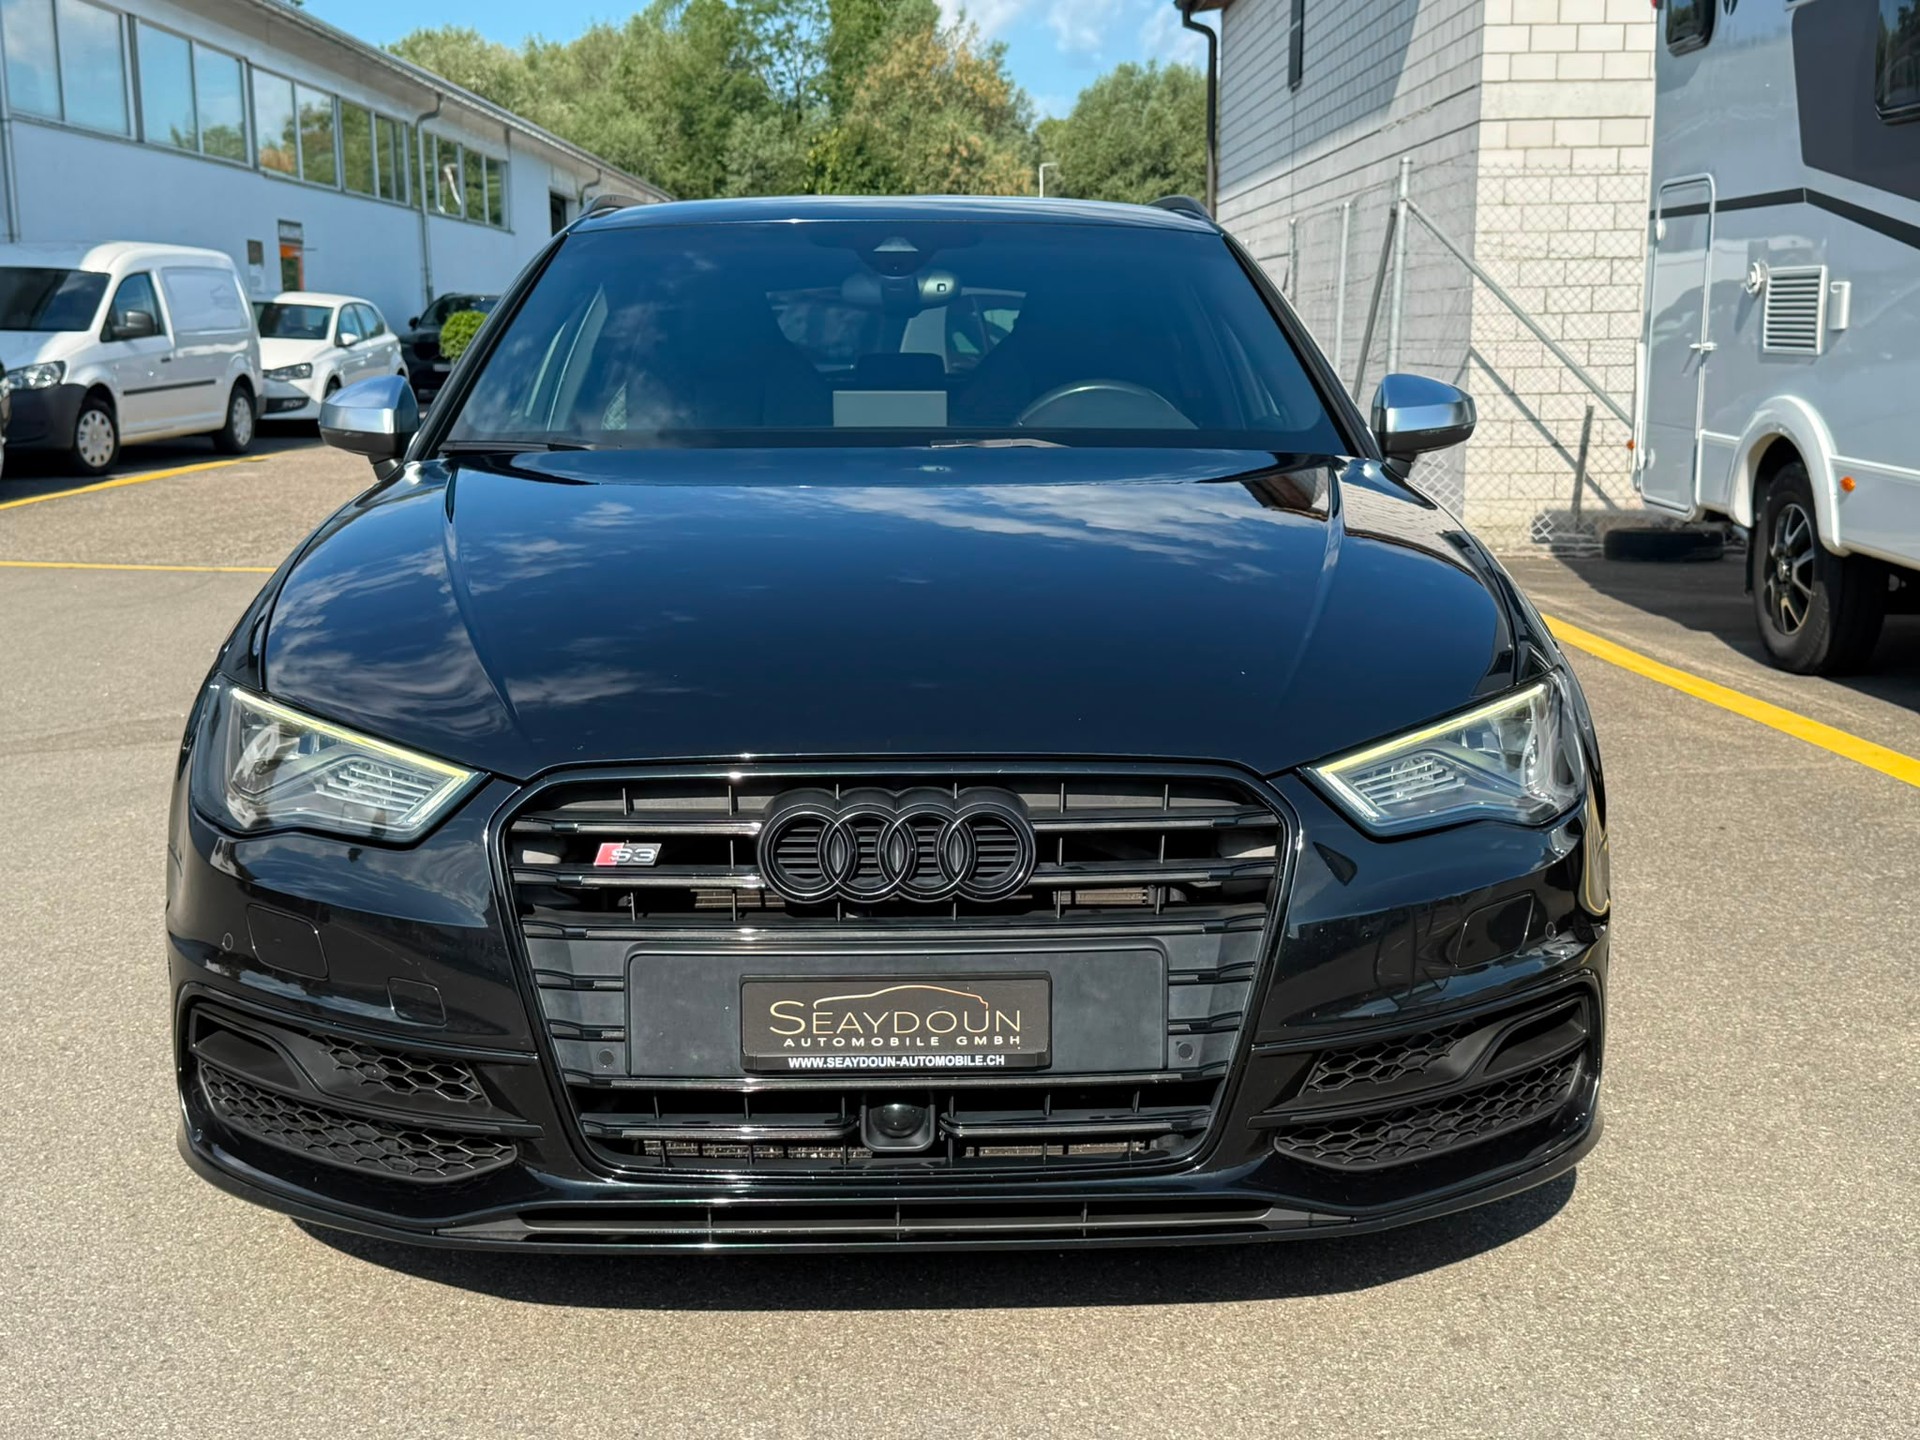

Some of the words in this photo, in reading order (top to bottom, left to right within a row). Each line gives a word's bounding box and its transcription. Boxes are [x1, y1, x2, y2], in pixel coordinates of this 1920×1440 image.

[609, 847, 657, 863] S3
[769, 1000, 1021, 1035] SEAYDOUN
[783, 1036, 940, 1048] AUTOMOBILE
[956, 1035, 1021, 1047] GMBH
[788, 1055, 1005, 1070] WWW.SEAYDOUN-AUTOMOBILE.CH
